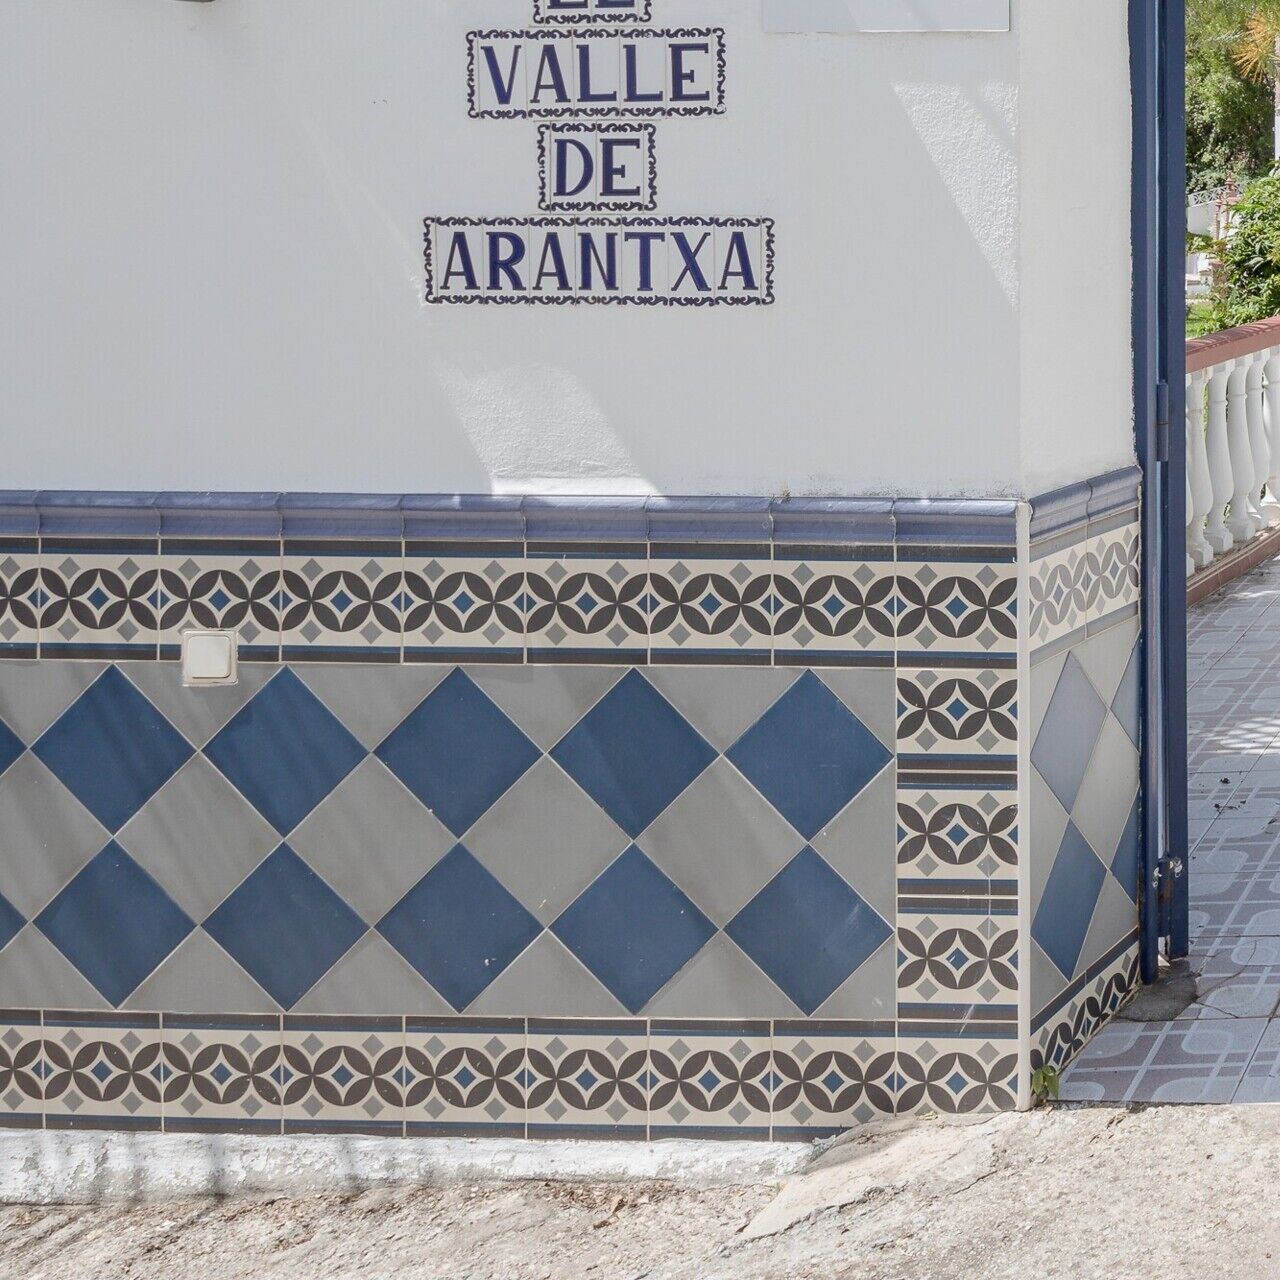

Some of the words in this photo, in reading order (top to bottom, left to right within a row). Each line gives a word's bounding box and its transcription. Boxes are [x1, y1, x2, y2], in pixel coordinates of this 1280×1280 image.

[480, 43, 710, 104] VALLE
[553, 138, 641, 197] DE
[440, 231, 758, 292] ARANTXA
